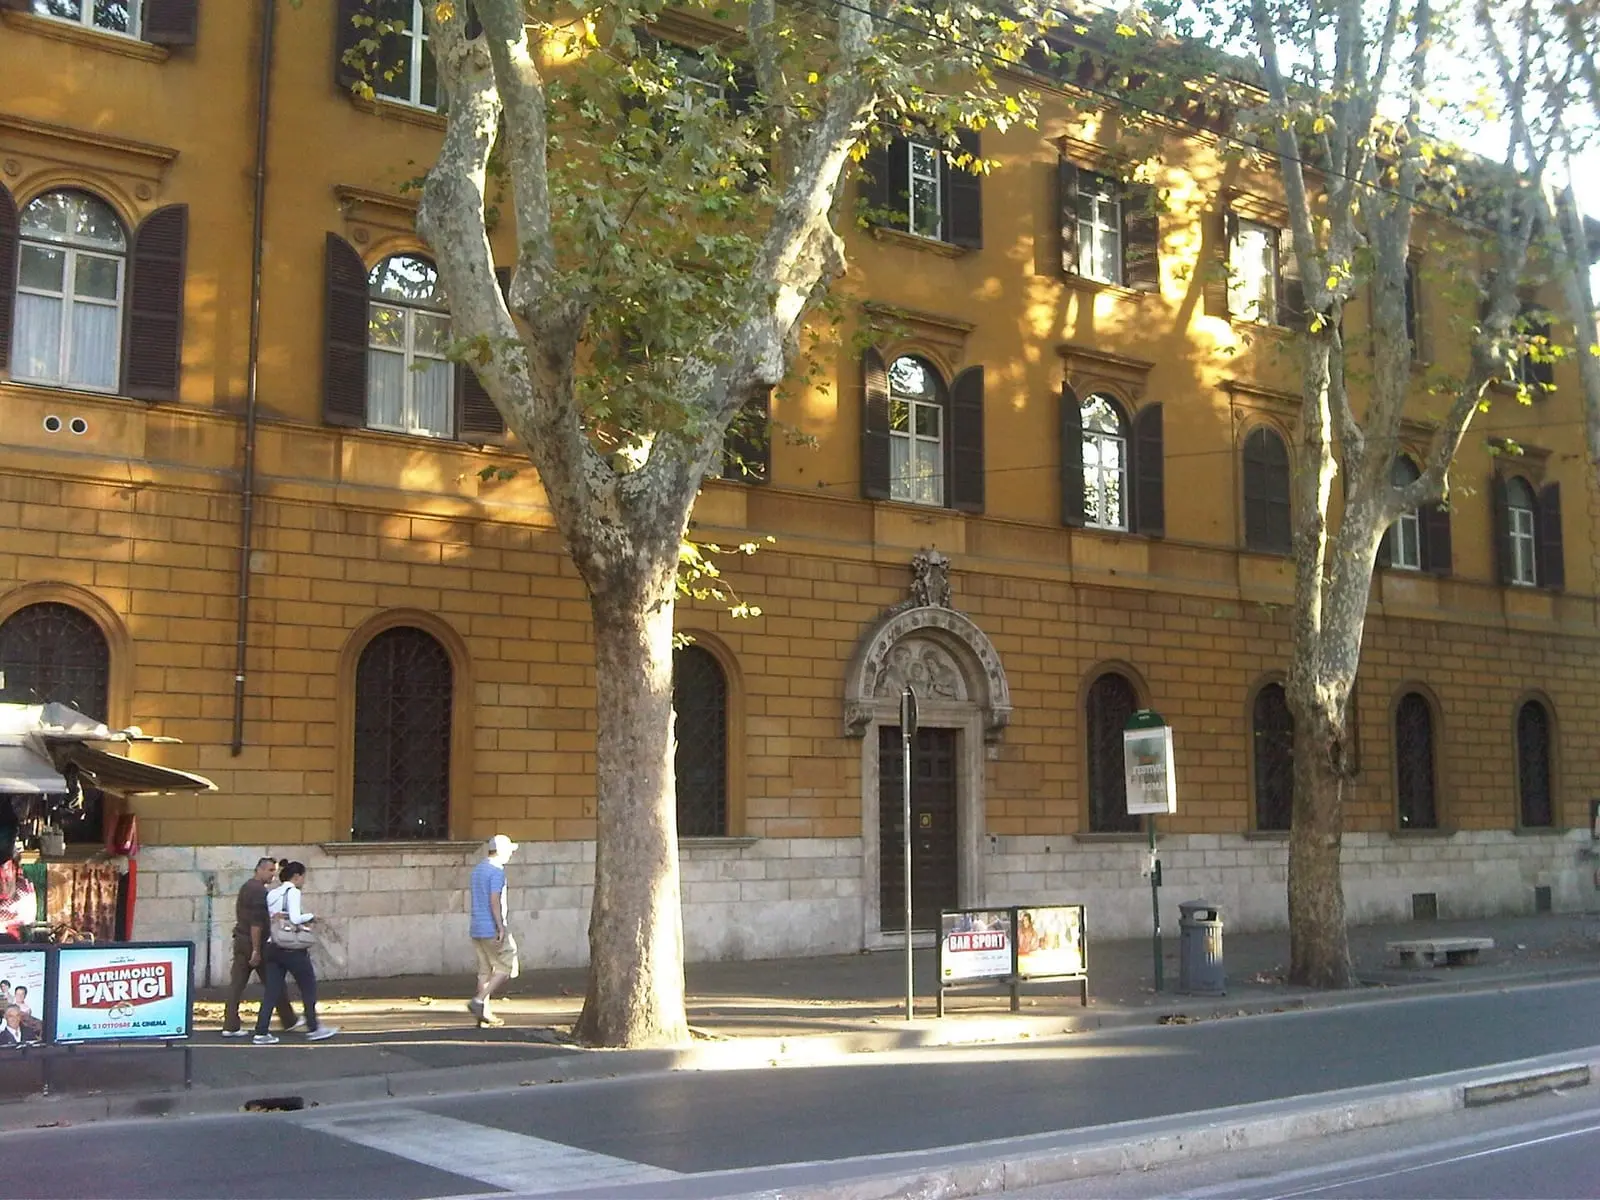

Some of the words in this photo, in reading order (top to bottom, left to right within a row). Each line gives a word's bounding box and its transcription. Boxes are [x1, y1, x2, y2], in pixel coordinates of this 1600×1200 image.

[950, 936, 970, 951] BAR
[972, 934, 1004, 949] SPORT
[79, 966, 165, 984] MATRIMONIO
[79, 976, 166, 1005] PARIGI
[141, 1020, 167, 1028] CINEMA
